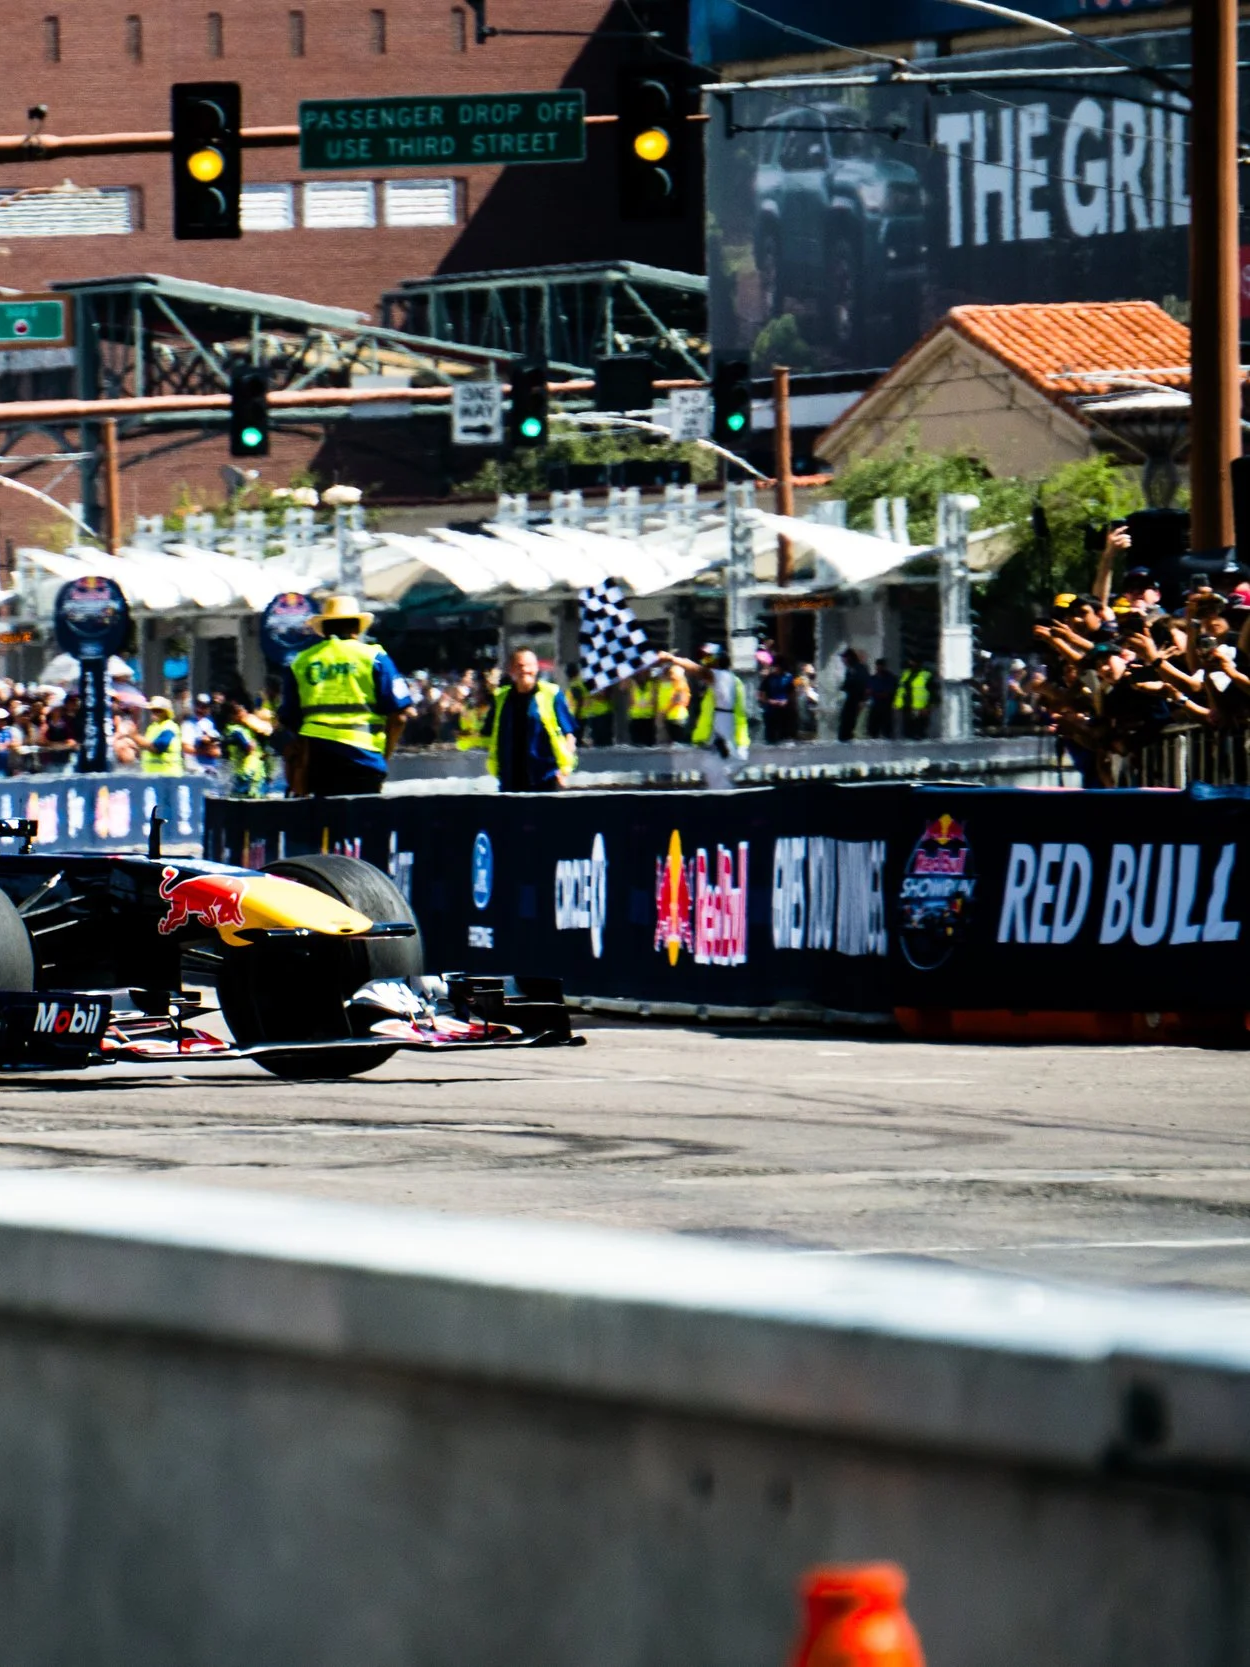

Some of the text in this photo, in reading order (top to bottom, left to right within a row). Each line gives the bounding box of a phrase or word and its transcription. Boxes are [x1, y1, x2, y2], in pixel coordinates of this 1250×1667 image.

[302, 101, 579, 131] PASSENGER DROP OFF
[326, 132, 558, 160] USE THIRD STREET
[936, 102, 1050, 248] THE
[461, 387, 496, 402] ONE
[460, 404, 495, 418] WAY
[997, 843, 1093, 944] RED
[1099, 843, 1242, 946] BULL
[33, 1002, 101, 1034] Mobil
